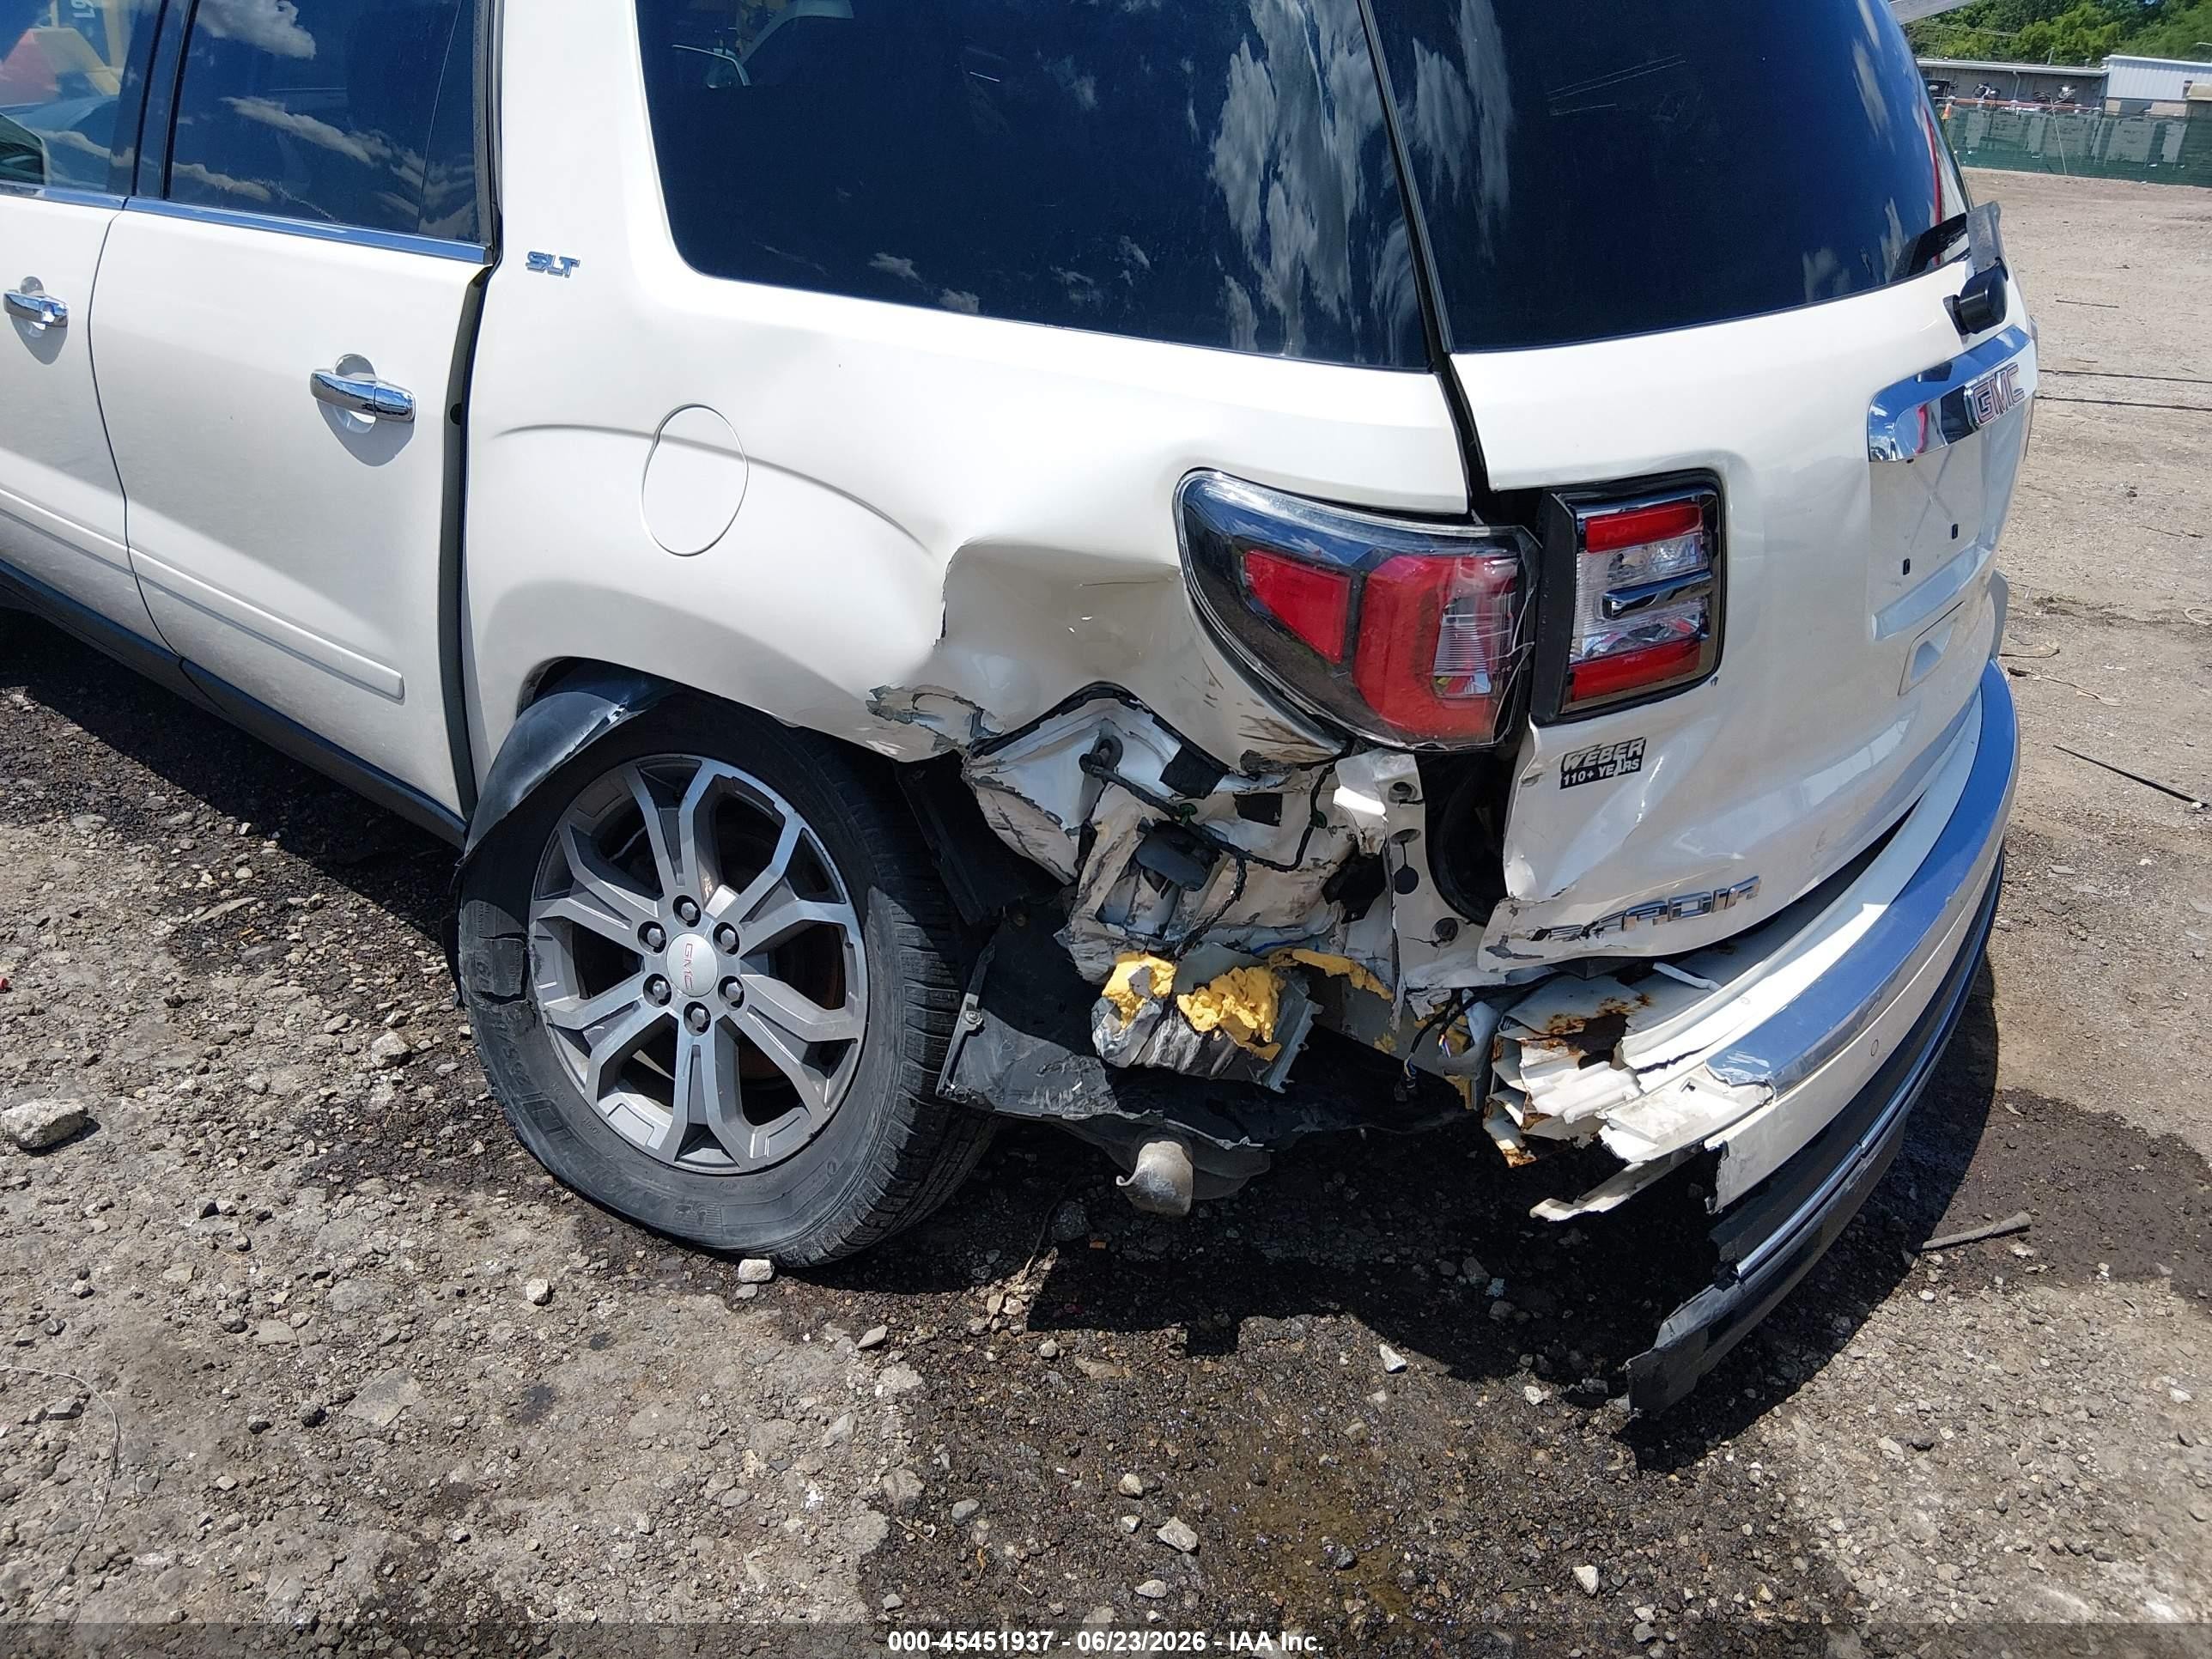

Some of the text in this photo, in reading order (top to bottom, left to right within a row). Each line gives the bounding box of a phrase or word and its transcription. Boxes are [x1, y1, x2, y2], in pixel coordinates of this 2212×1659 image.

[525, 251, 581, 279] SLT
[1972, 362, 2027, 425] GMC
[1563, 738, 1644, 773] WEBER
[1563, 770, 1595, 786] 110+
[682, 942, 695, 991] GMC
